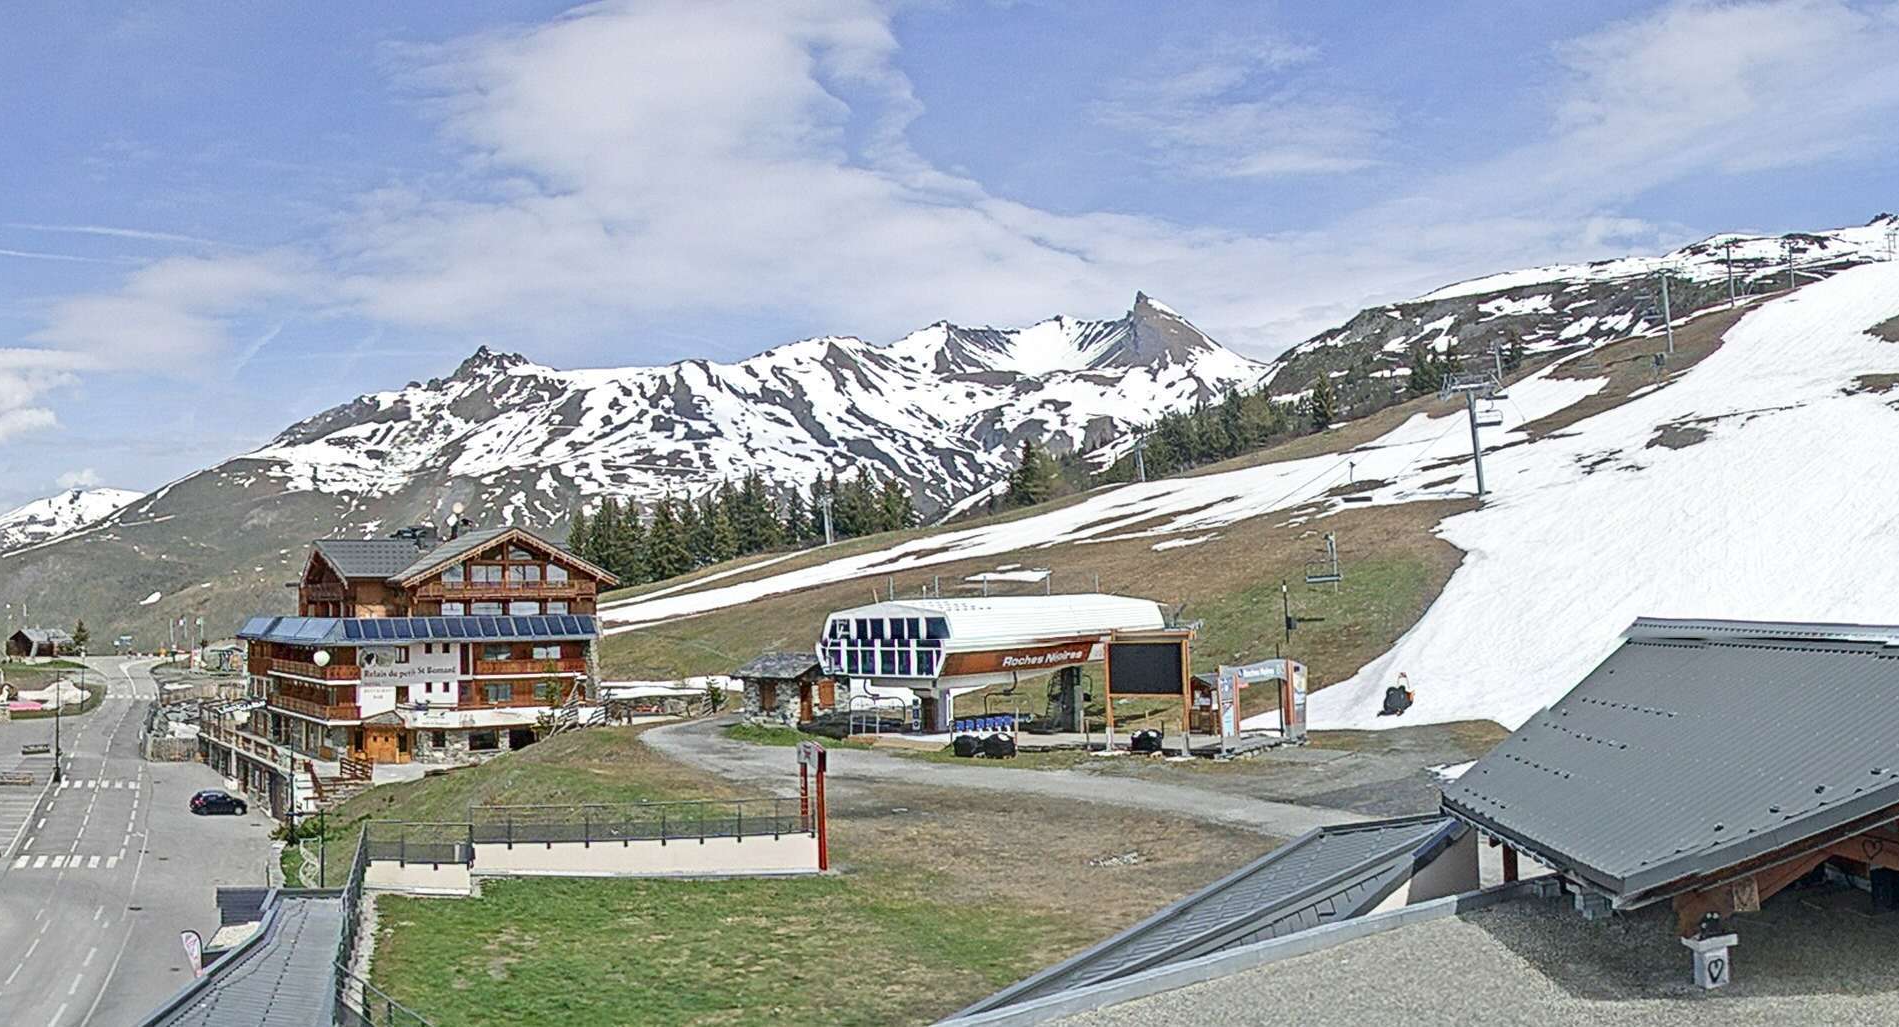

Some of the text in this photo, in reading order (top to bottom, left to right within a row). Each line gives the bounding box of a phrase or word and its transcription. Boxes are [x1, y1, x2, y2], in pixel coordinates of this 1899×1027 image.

[1002, 651, 1082, 667] Roches Noires
[364, 670, 387, 678] Relais
[417, 666, 425, 674] St
